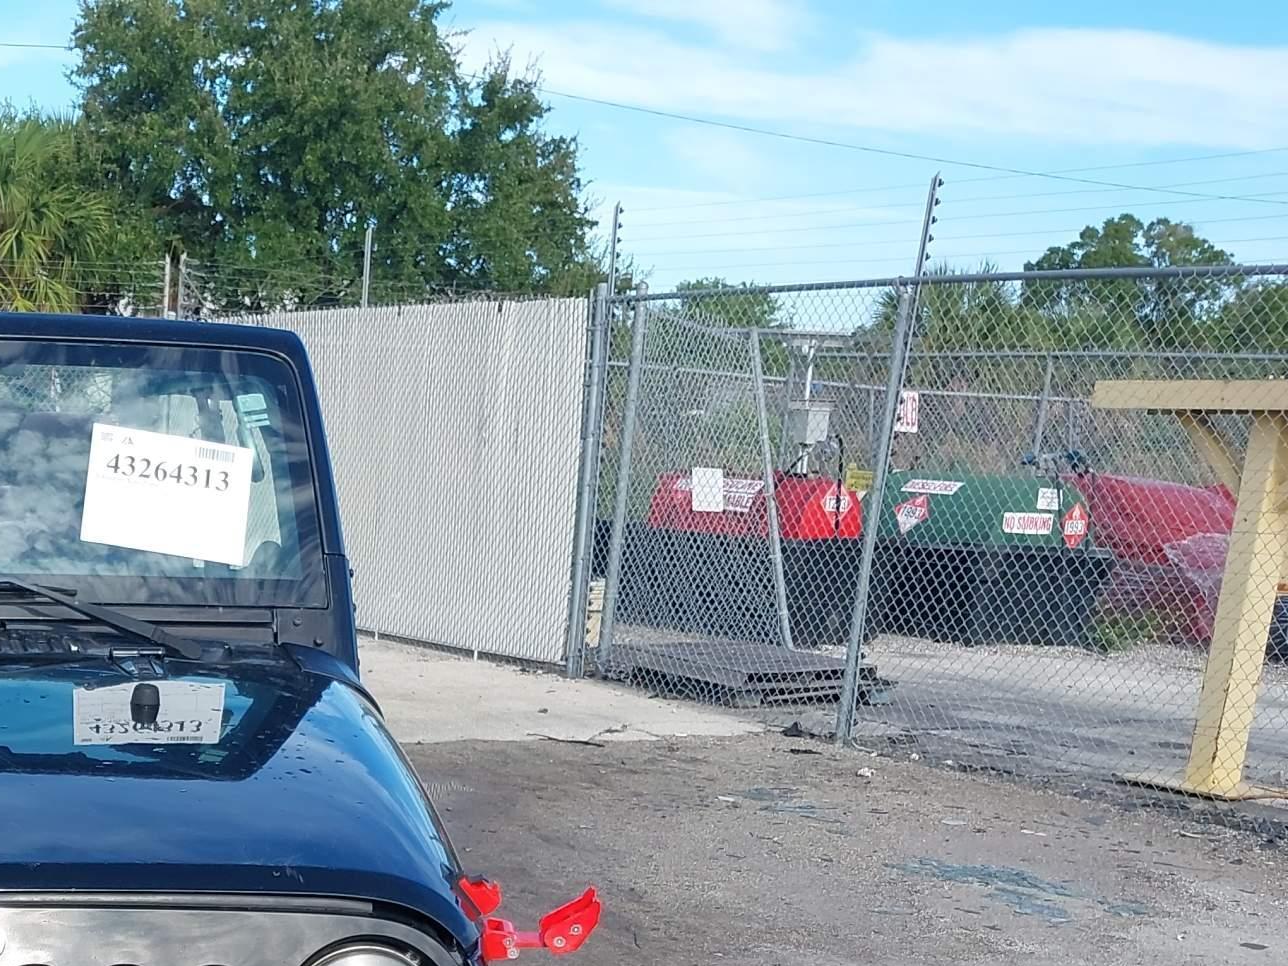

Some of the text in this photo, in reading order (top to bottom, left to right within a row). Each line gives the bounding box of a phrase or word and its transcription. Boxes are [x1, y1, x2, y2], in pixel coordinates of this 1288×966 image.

[106, 453, 229, 492] 43264313
[1003, 515, 1052, 531] NO SMOKING
[1064, 520, 1085, 534] 1993
